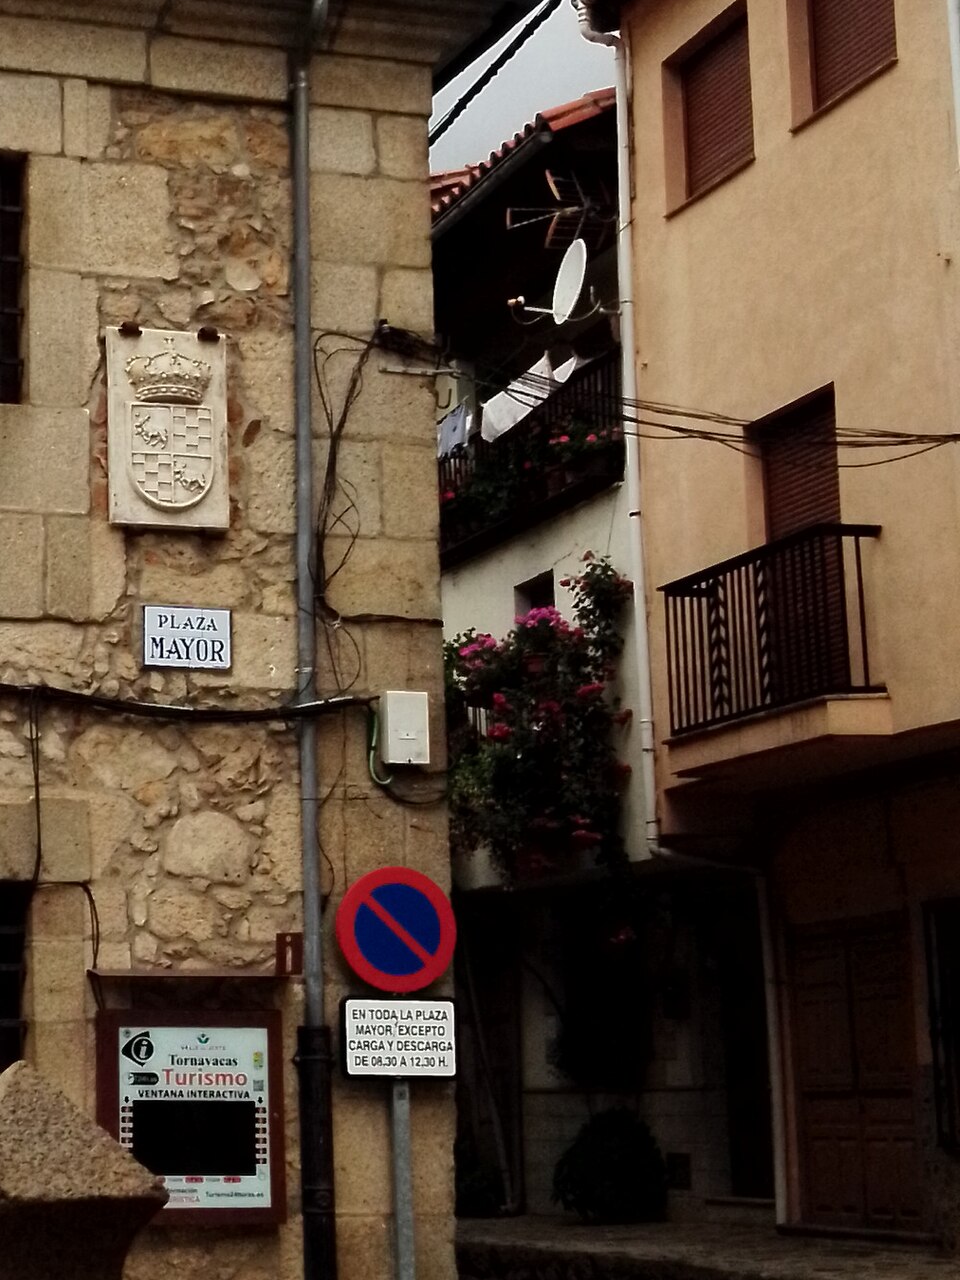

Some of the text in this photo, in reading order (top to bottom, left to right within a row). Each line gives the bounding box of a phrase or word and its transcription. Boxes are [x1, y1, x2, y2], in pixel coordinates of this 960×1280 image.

[157, 614, 218, 631] PLAZA
[150, 636, 224, 662] MAYOR
[352, 1009, 448, 1021] EN TODA LA PLAZA
[398, 1025, 445, 1036] EXCEPTO
[348, 1040, 453, 1052] CARGA Y DESCARGA
[168, 1054, 238, 1066] Tornavacas
[354, 1055, 448, 1067] DE 08.30 A 12.30 H.
[162, 1068, 247, 1086] Turismo
[138, 1089, 250, 1099] VENTANA INTERACTIVA
